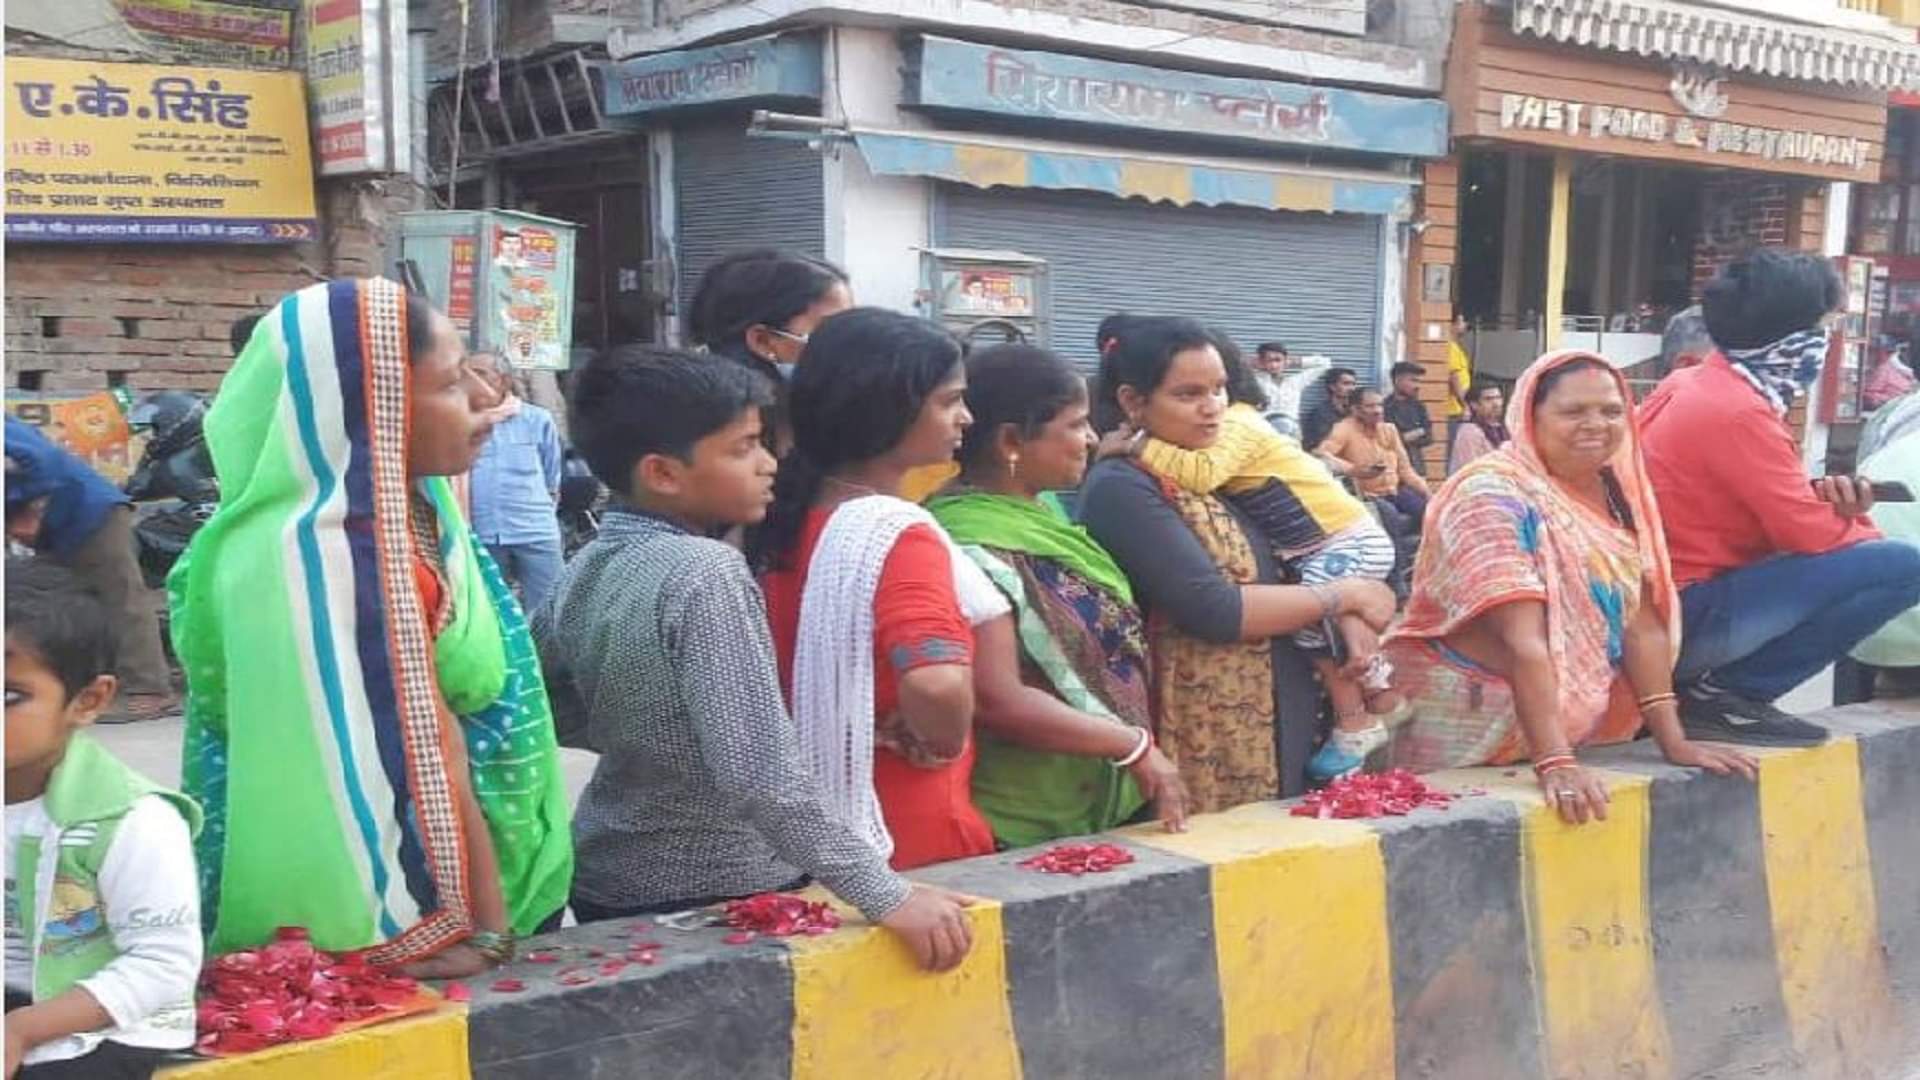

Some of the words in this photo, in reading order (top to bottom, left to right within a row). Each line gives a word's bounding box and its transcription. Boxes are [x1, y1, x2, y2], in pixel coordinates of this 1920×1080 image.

[1501, 93, 1584, 137] FAST
[1590, 105, 1668, 142] FOOD
[1674, 116, 1703, 148] &
[1707, 119, 1872, 171] RESTAURANT
